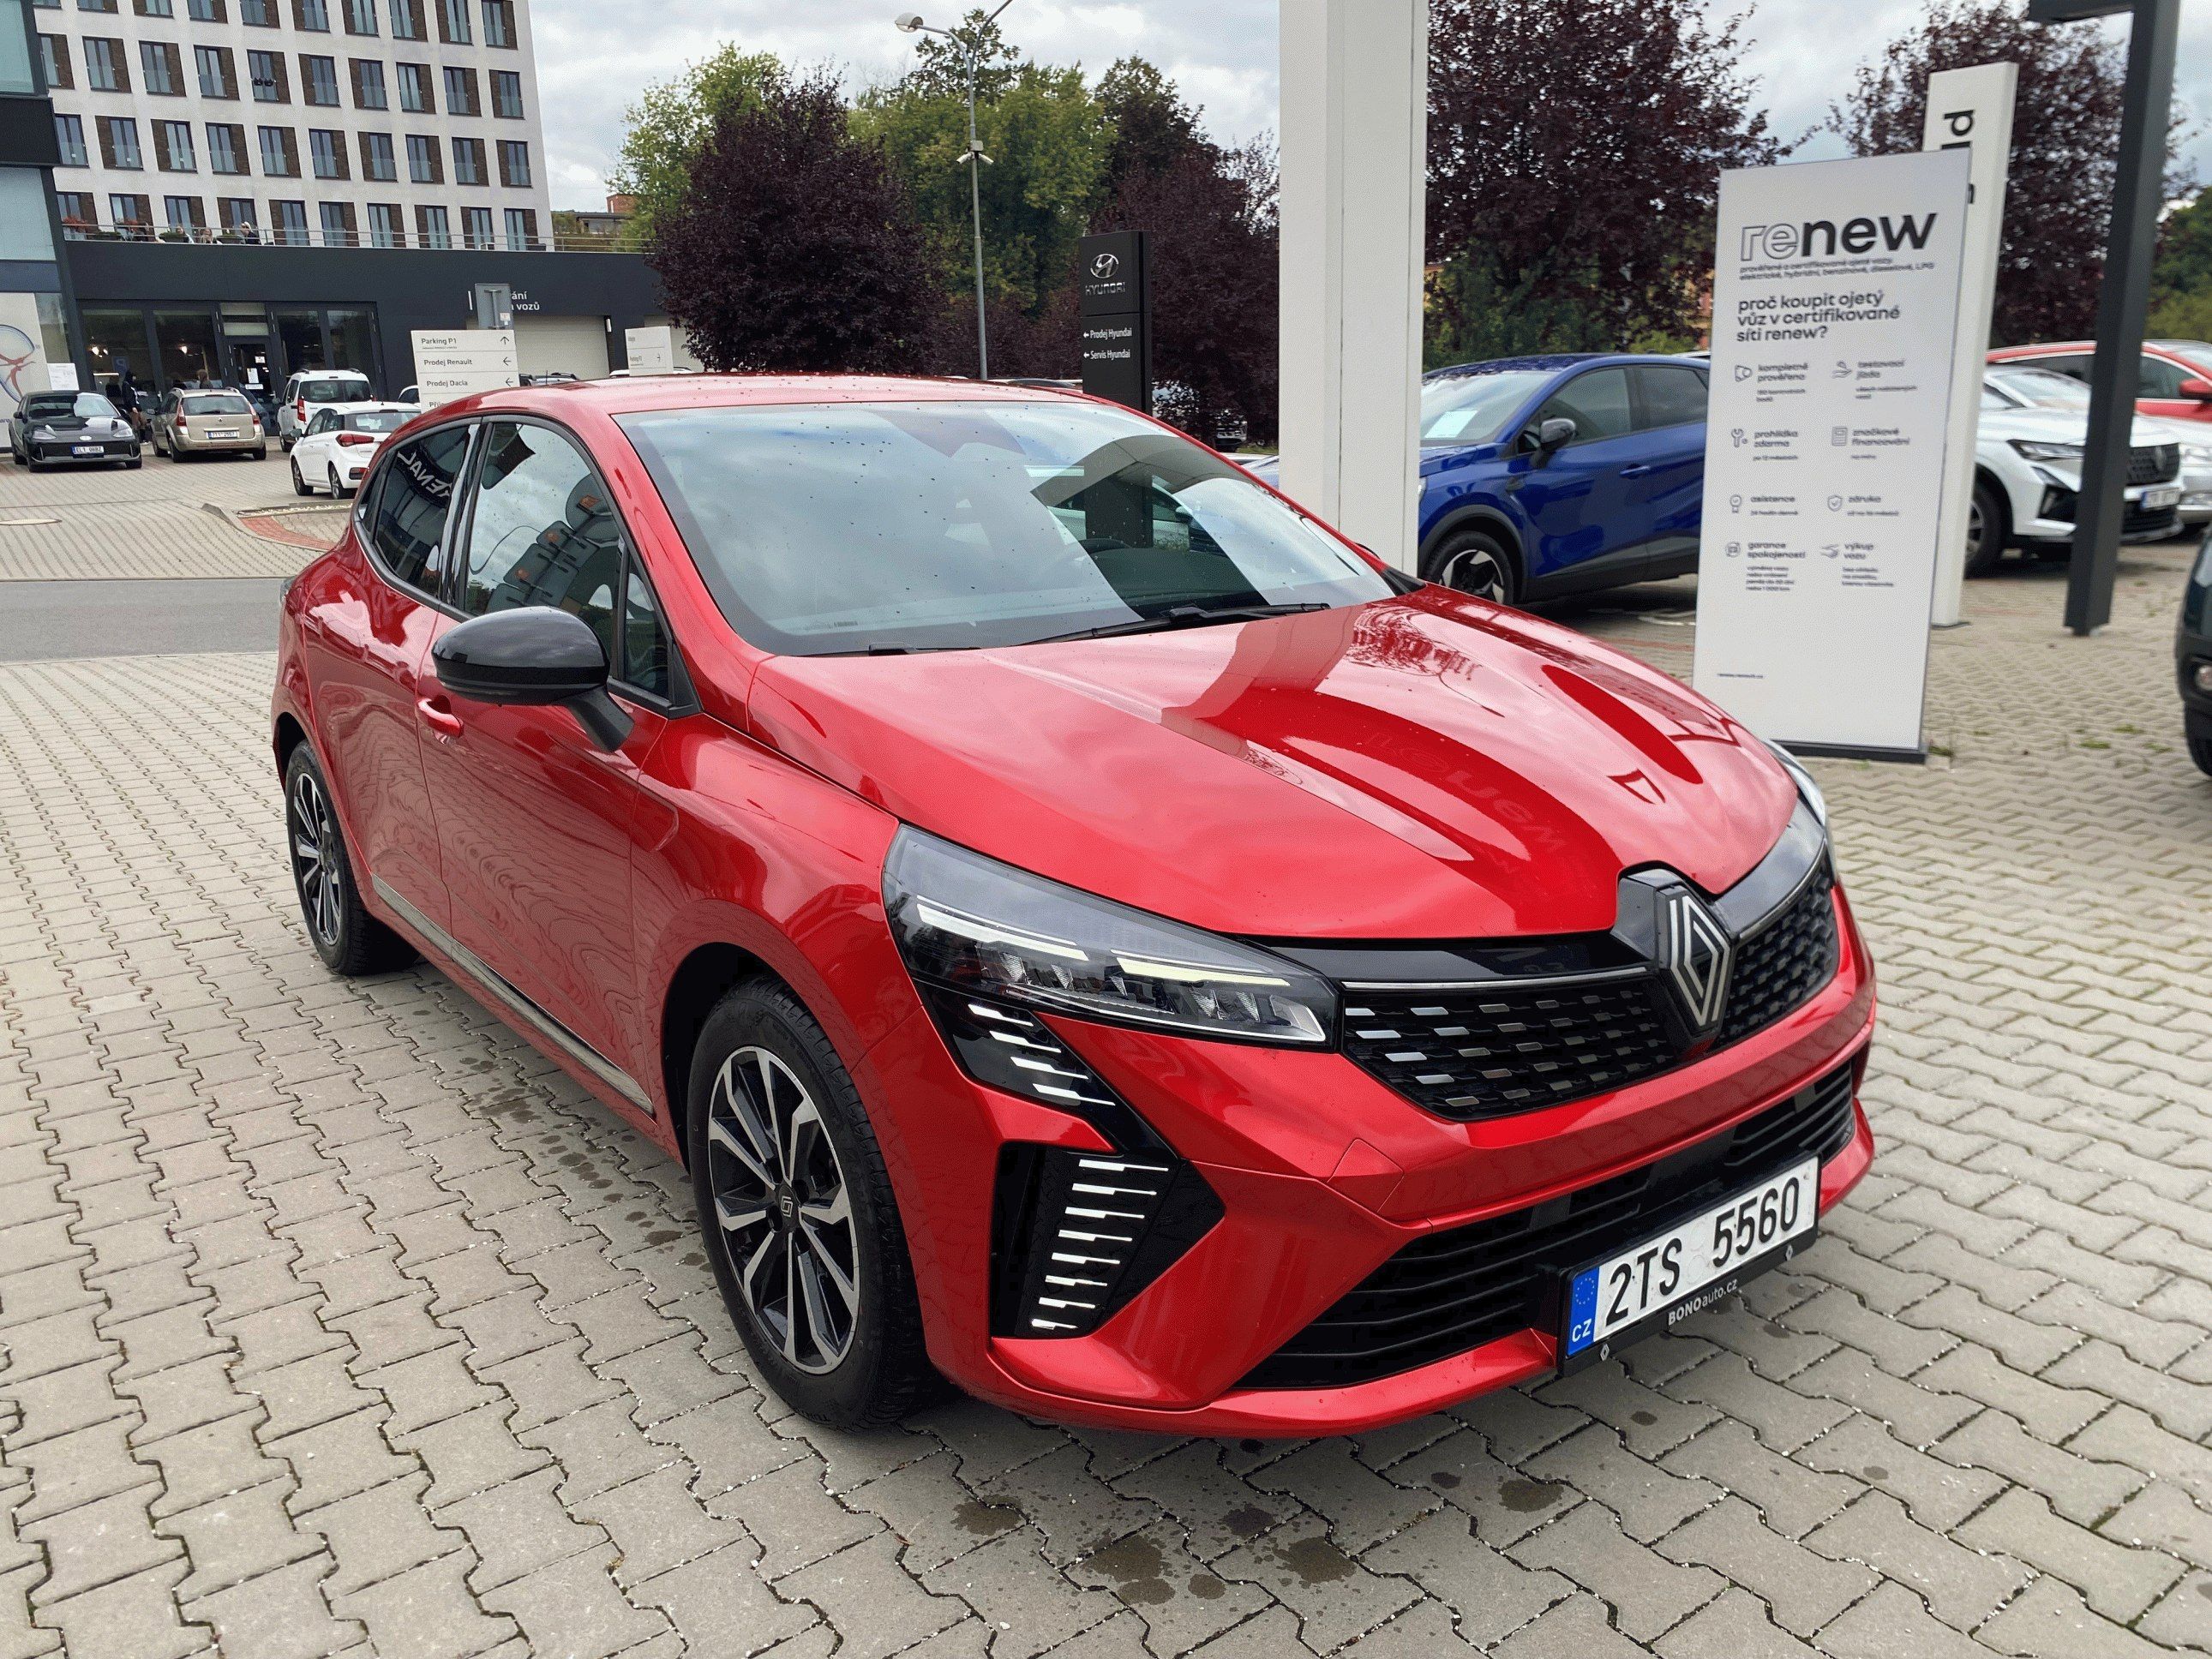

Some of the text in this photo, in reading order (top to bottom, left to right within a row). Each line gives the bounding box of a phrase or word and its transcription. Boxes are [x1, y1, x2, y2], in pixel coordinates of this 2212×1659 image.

[1740, 213, 1939, 262] renew
[1085, 282, 1125, 296] HYUNDAI
[1738, 290, 1884, 314] proč koupit ojetý
[1738, 305, 1900, 326] vůz v certifikované
[1089, 327, 1132, 340] Prodej Hyundai
[1736, 326, 1828, 342] síti renew?
[1090, 349, 1131, 361] Servis Hyundai
[1572, 1176, 1800, 1343] CZ 2TS 5560
[1668, 1279, 1737, 1327] BONOauto.cz
